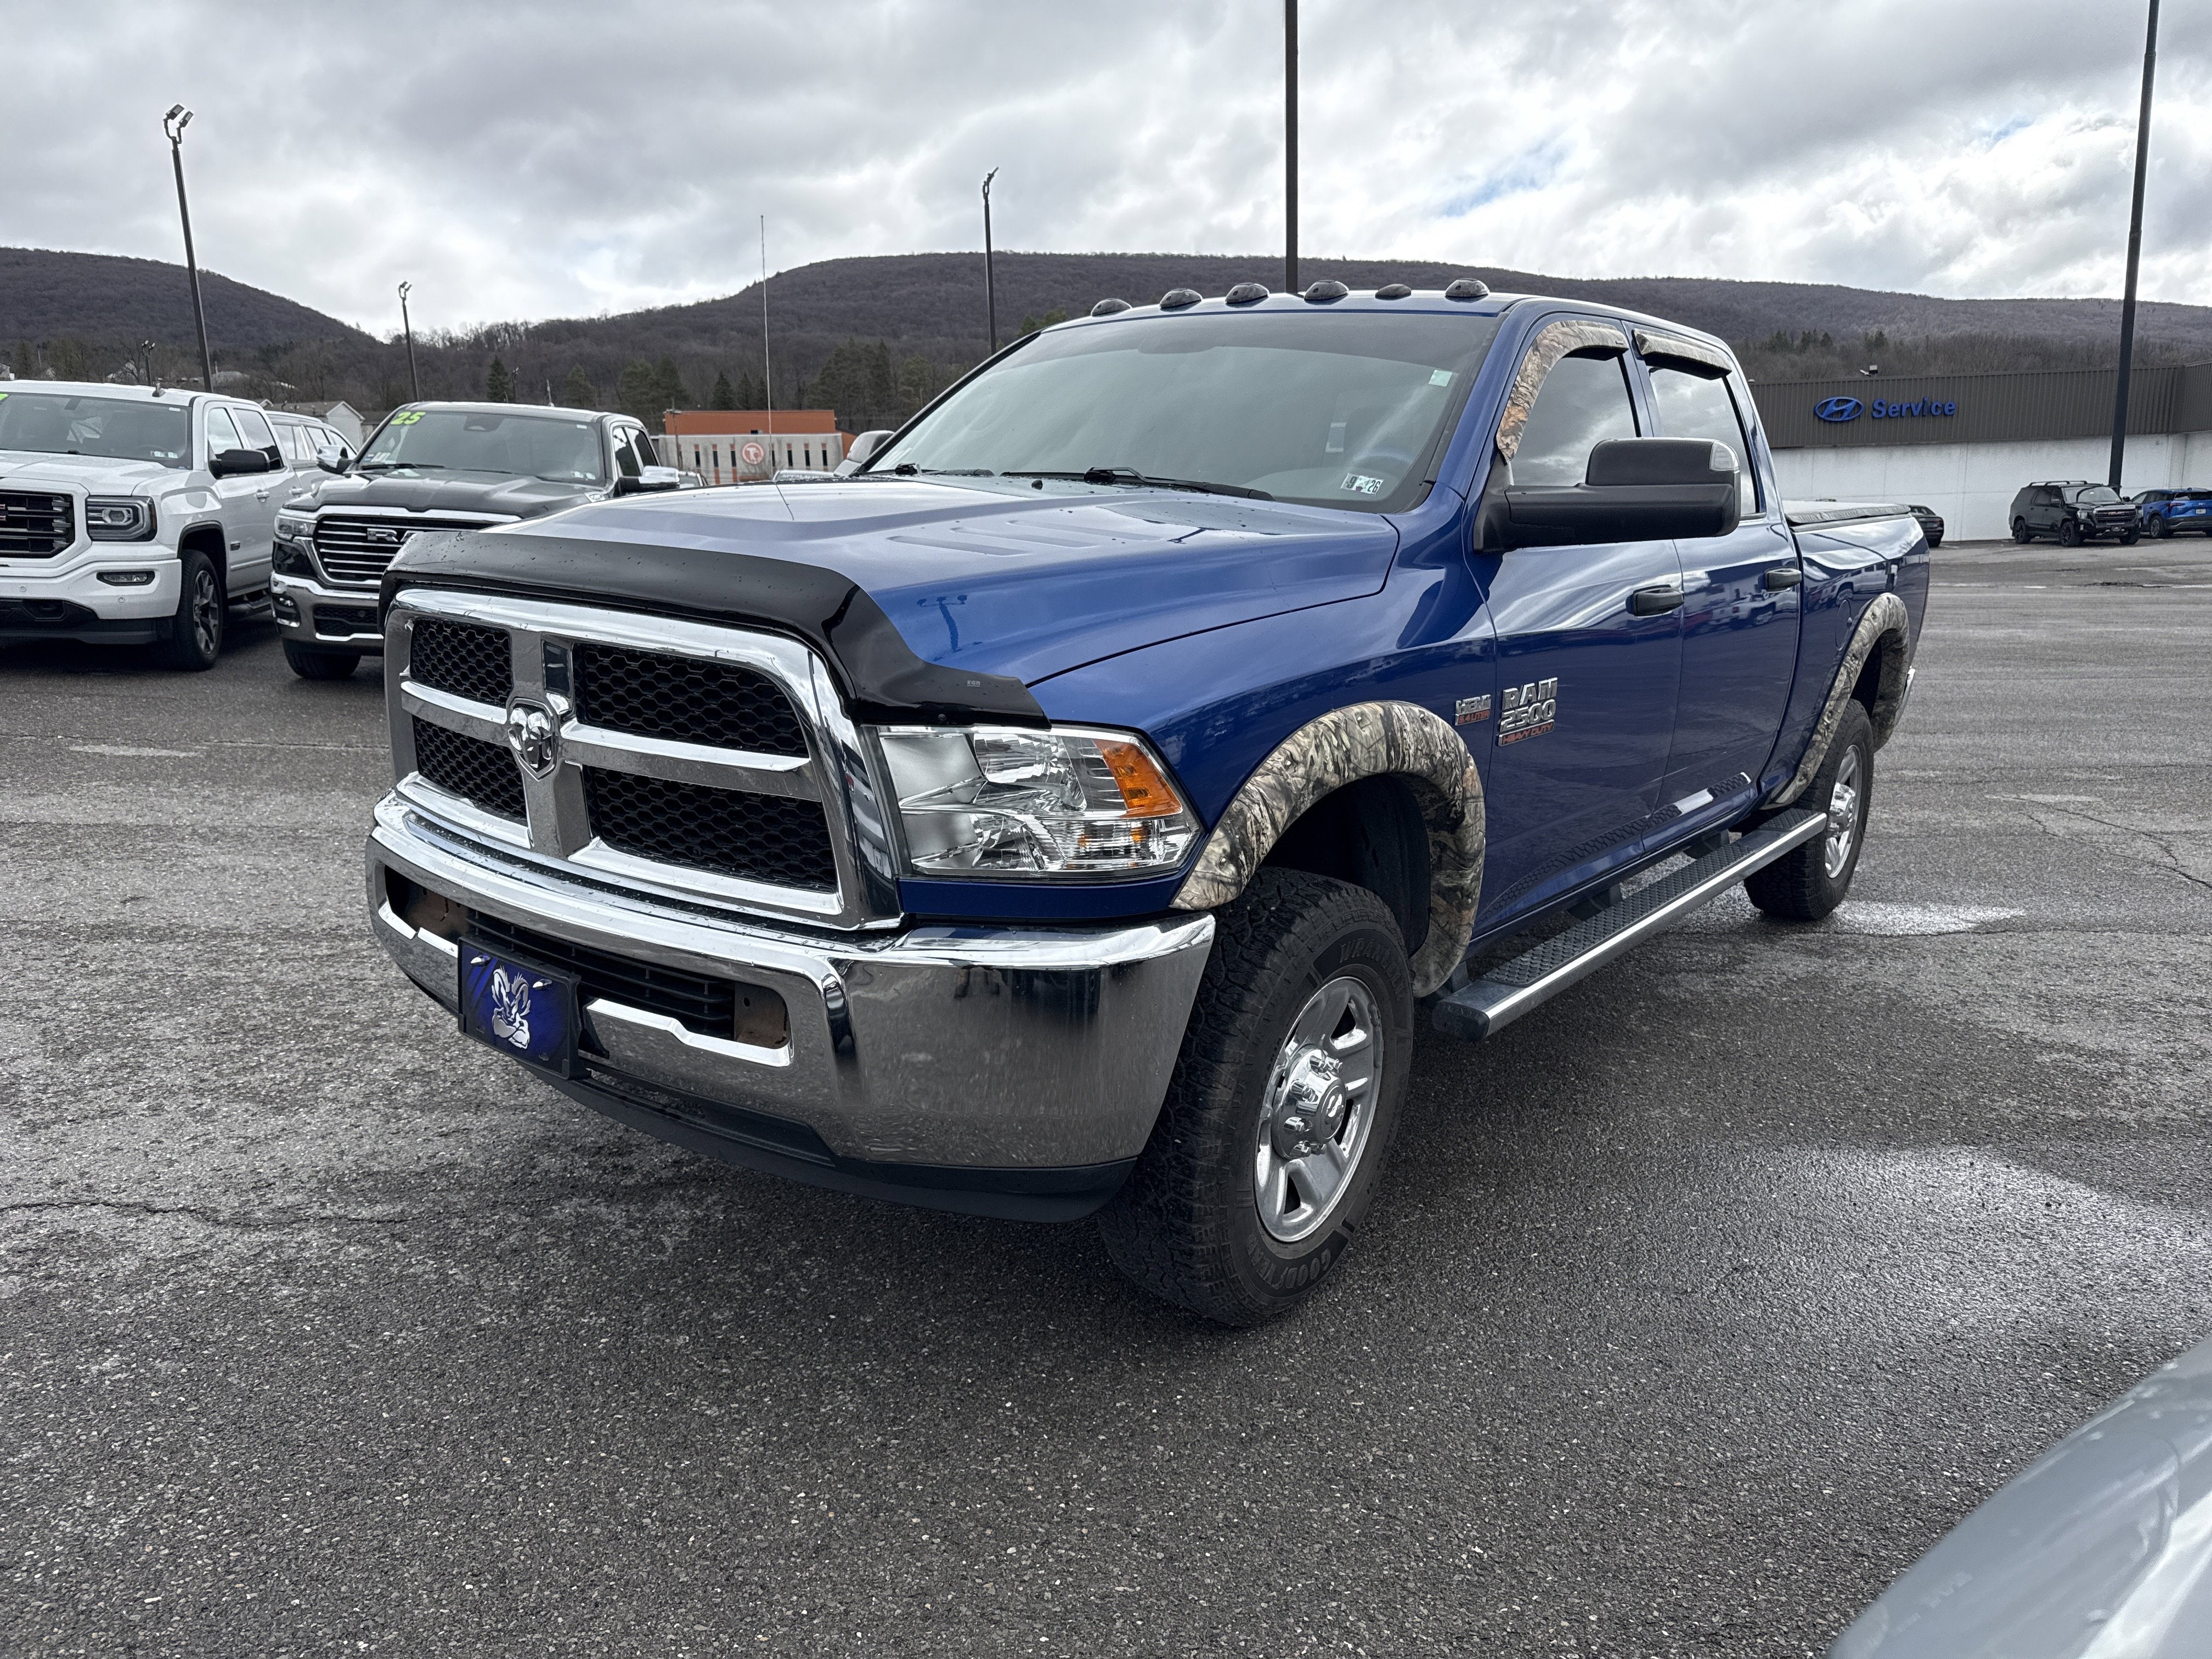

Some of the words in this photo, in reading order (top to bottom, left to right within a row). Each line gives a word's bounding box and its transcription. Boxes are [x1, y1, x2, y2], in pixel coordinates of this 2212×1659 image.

[1872, 397, 1956, 418] Service
[391, 411, 426, 425] 25
[1347, 476, 1358, 489] 9
[1368, 479, 1381, 493] 26
[1502, 677, 1558, 710] RAM
[1455, 694, 1491, 714] HEMI
[1471, 709, 1490, 721] LITER
[1499, 698, 1556, 732] 2500
[1503, 730, 1531, 744] HEAVY
[1531, 723, 1553, 736] DUTY
